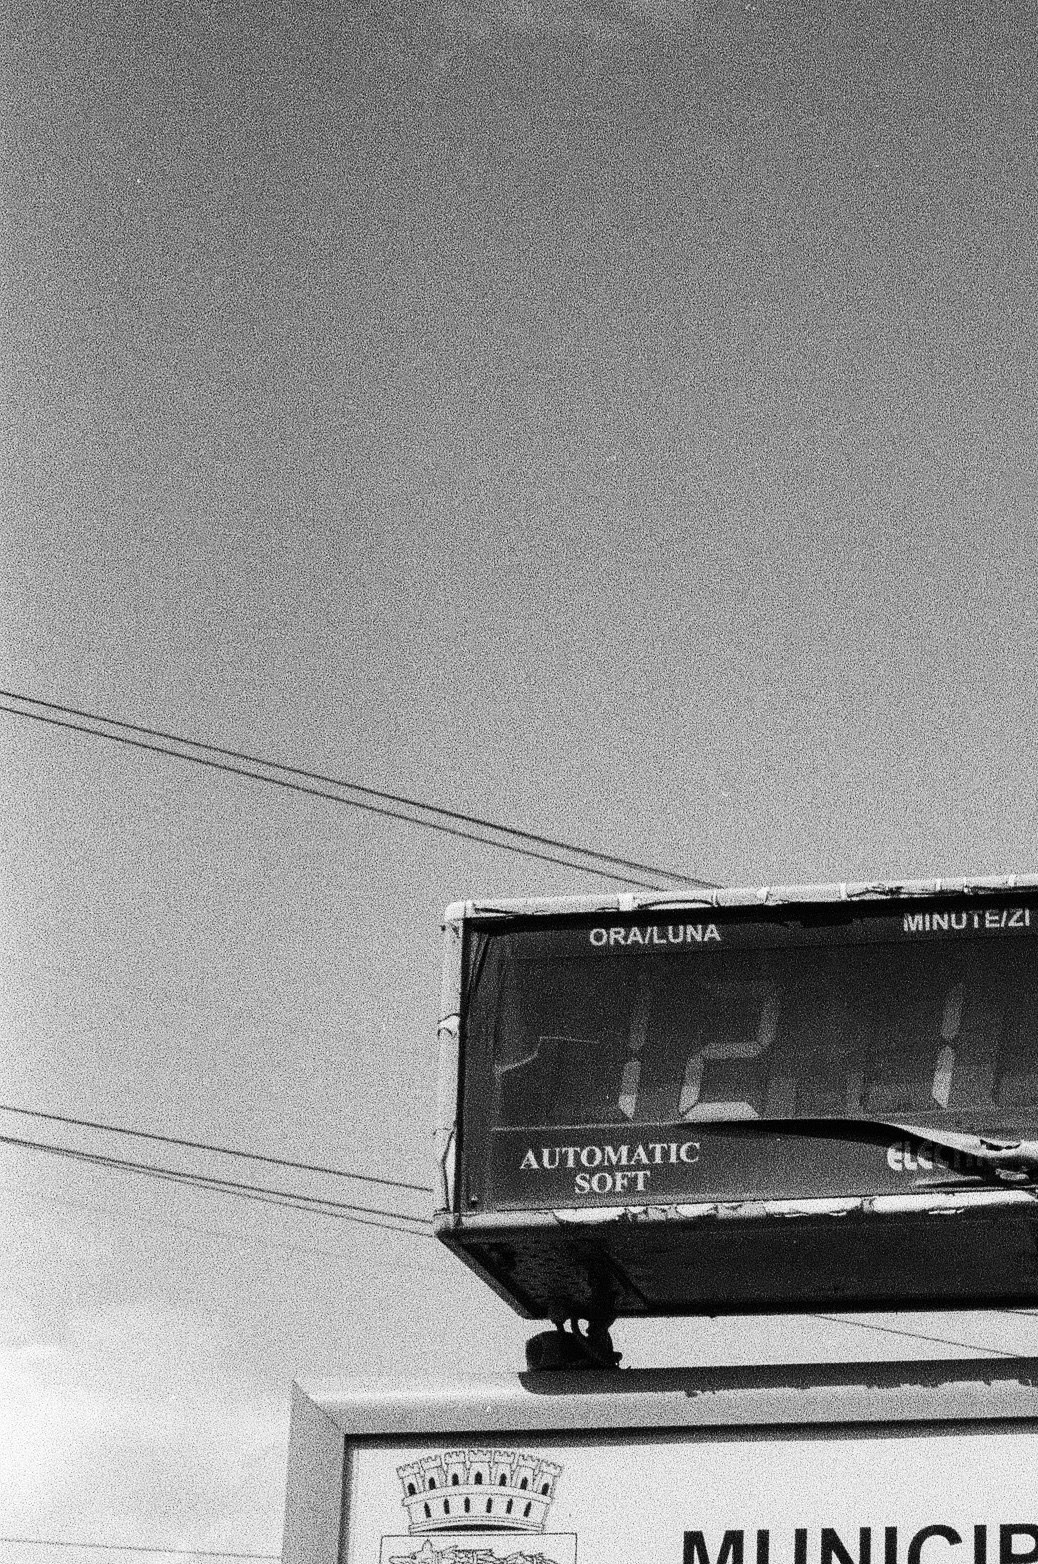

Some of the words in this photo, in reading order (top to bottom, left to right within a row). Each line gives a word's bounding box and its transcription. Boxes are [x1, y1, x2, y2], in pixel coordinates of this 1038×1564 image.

[903, 907, 1031, 932] MINUTE/ZI
[589, 924, 721, 947] ORA/LUNA
[520, 1142, 700, 1169] AUTOMATIC
[574, 1171, 650, 1194] SOFT
